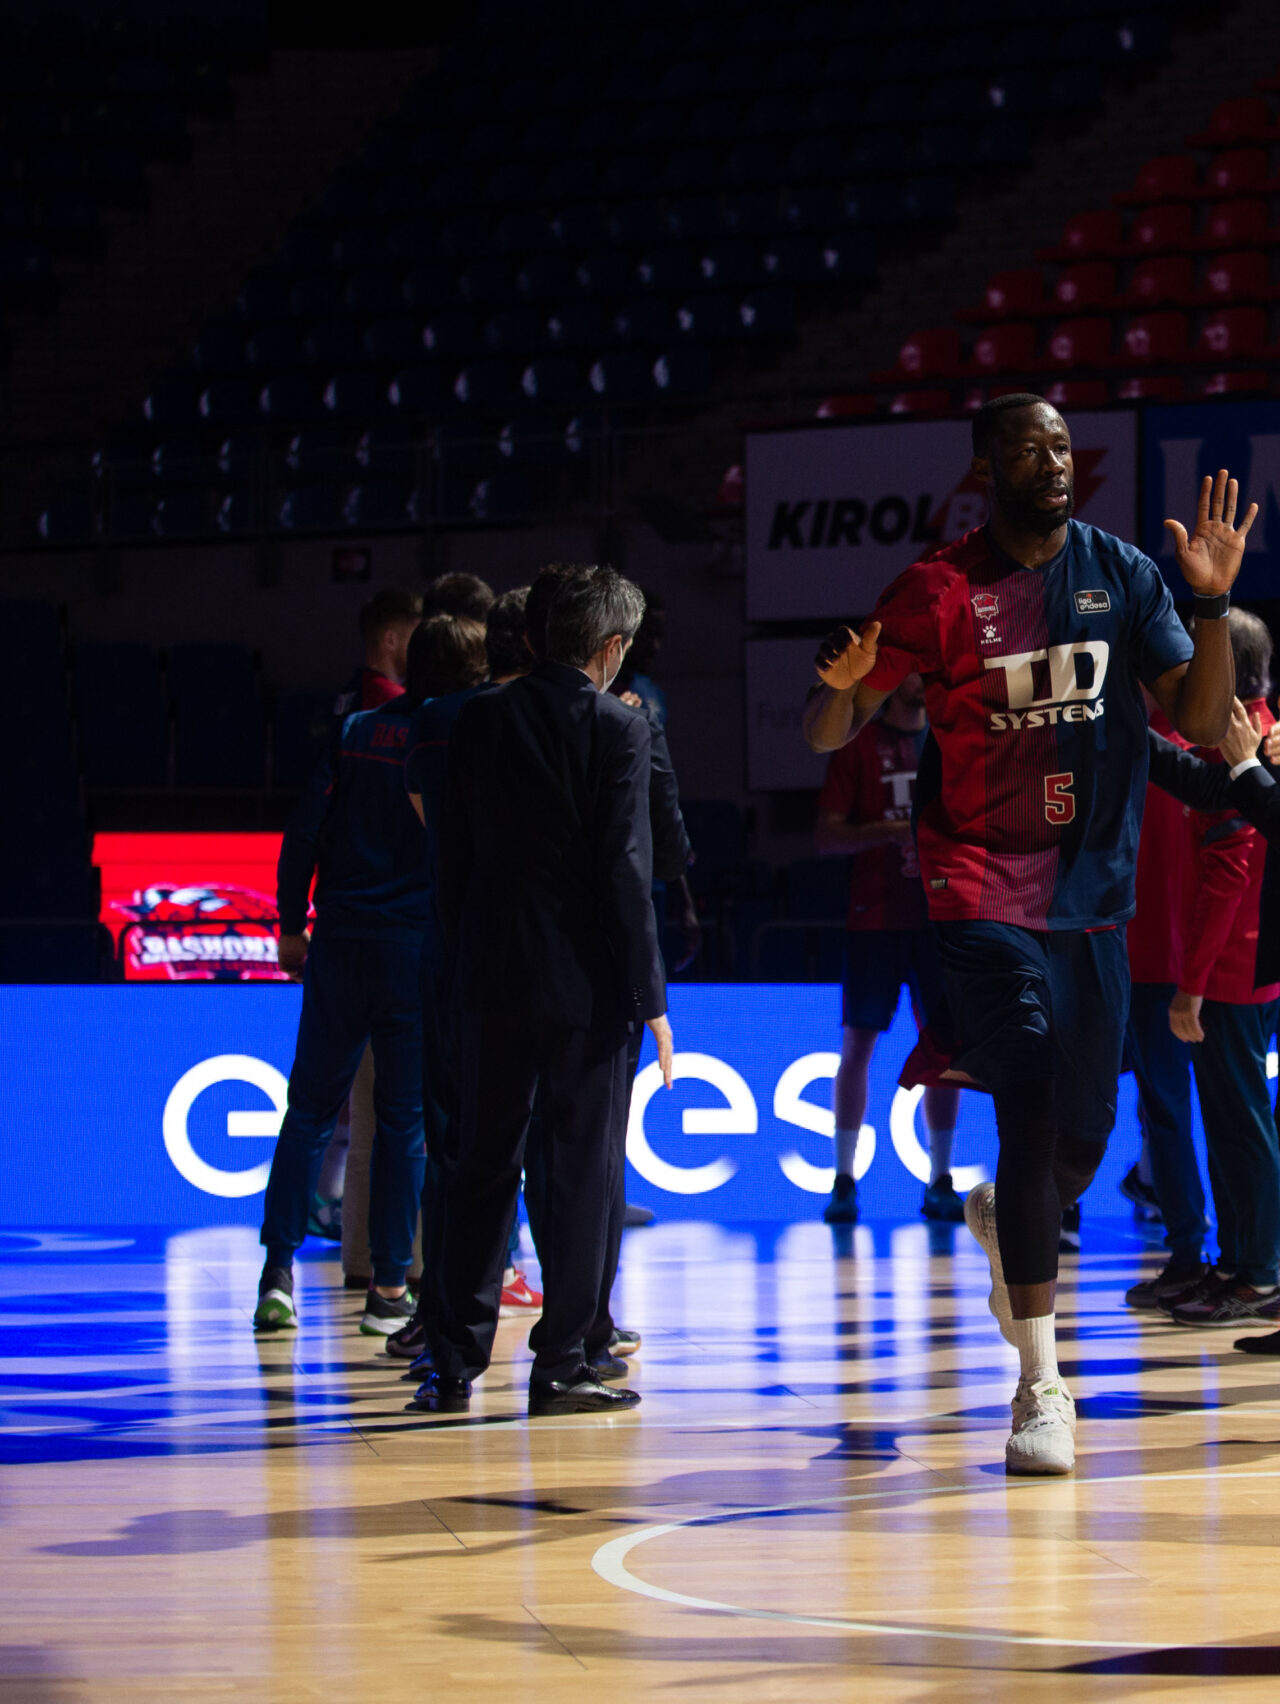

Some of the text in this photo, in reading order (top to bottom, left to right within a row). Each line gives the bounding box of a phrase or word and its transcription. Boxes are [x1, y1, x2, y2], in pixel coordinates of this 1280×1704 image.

[768, 490, 990, 549] KIROLB
[980, 636, 1003, 645] KELME
[983, 639, 1110, 710] TD
[1044, 771, 1076, 825] 5
